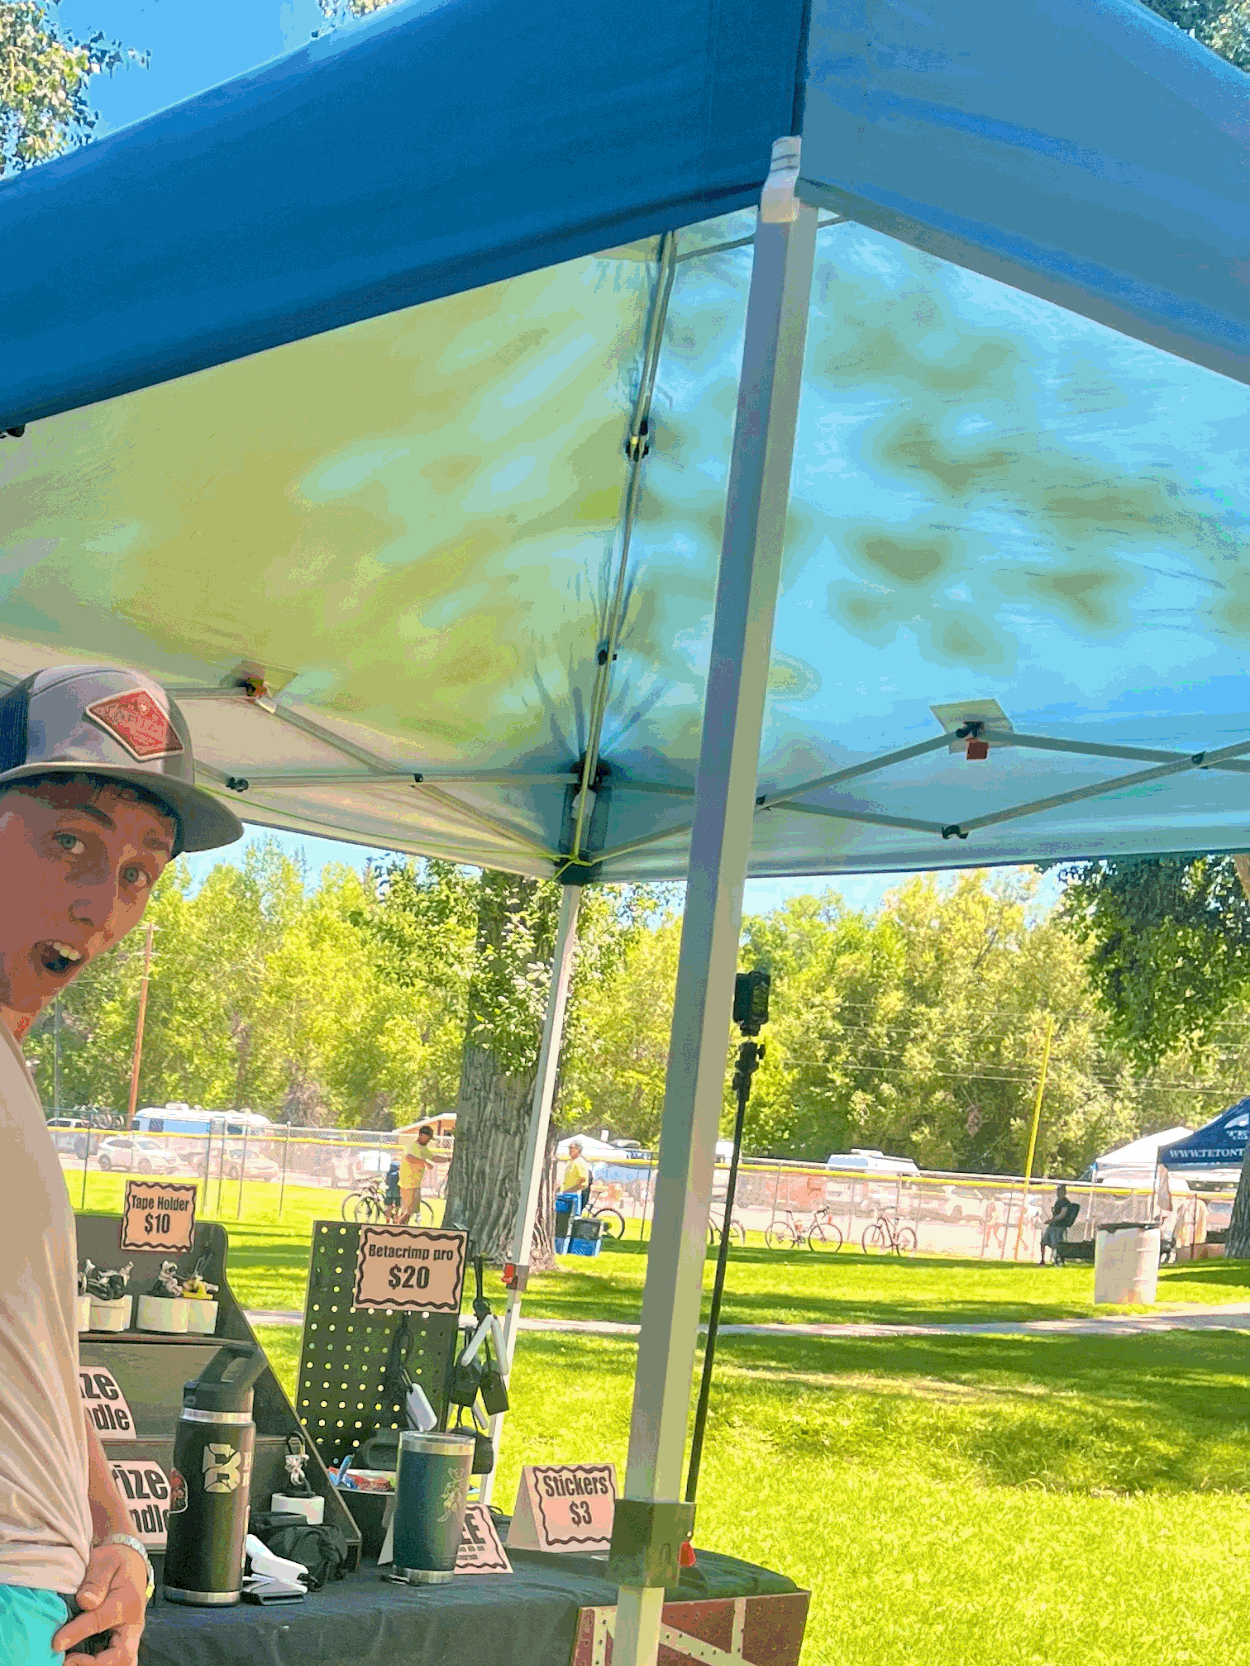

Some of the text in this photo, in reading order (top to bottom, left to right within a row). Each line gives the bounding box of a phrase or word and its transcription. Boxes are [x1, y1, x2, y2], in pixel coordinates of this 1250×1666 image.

[131, 1194, 190, 1212] Tape Holder
[144, 1211, 171, 1236] $10
[368, 1243, 454, 1262] Betacrimp pro
[387, 1263, 431, 1290] $20
[543, 1474, 609, 1498] Stickers
[569, 1500, 592, 1527] $3
